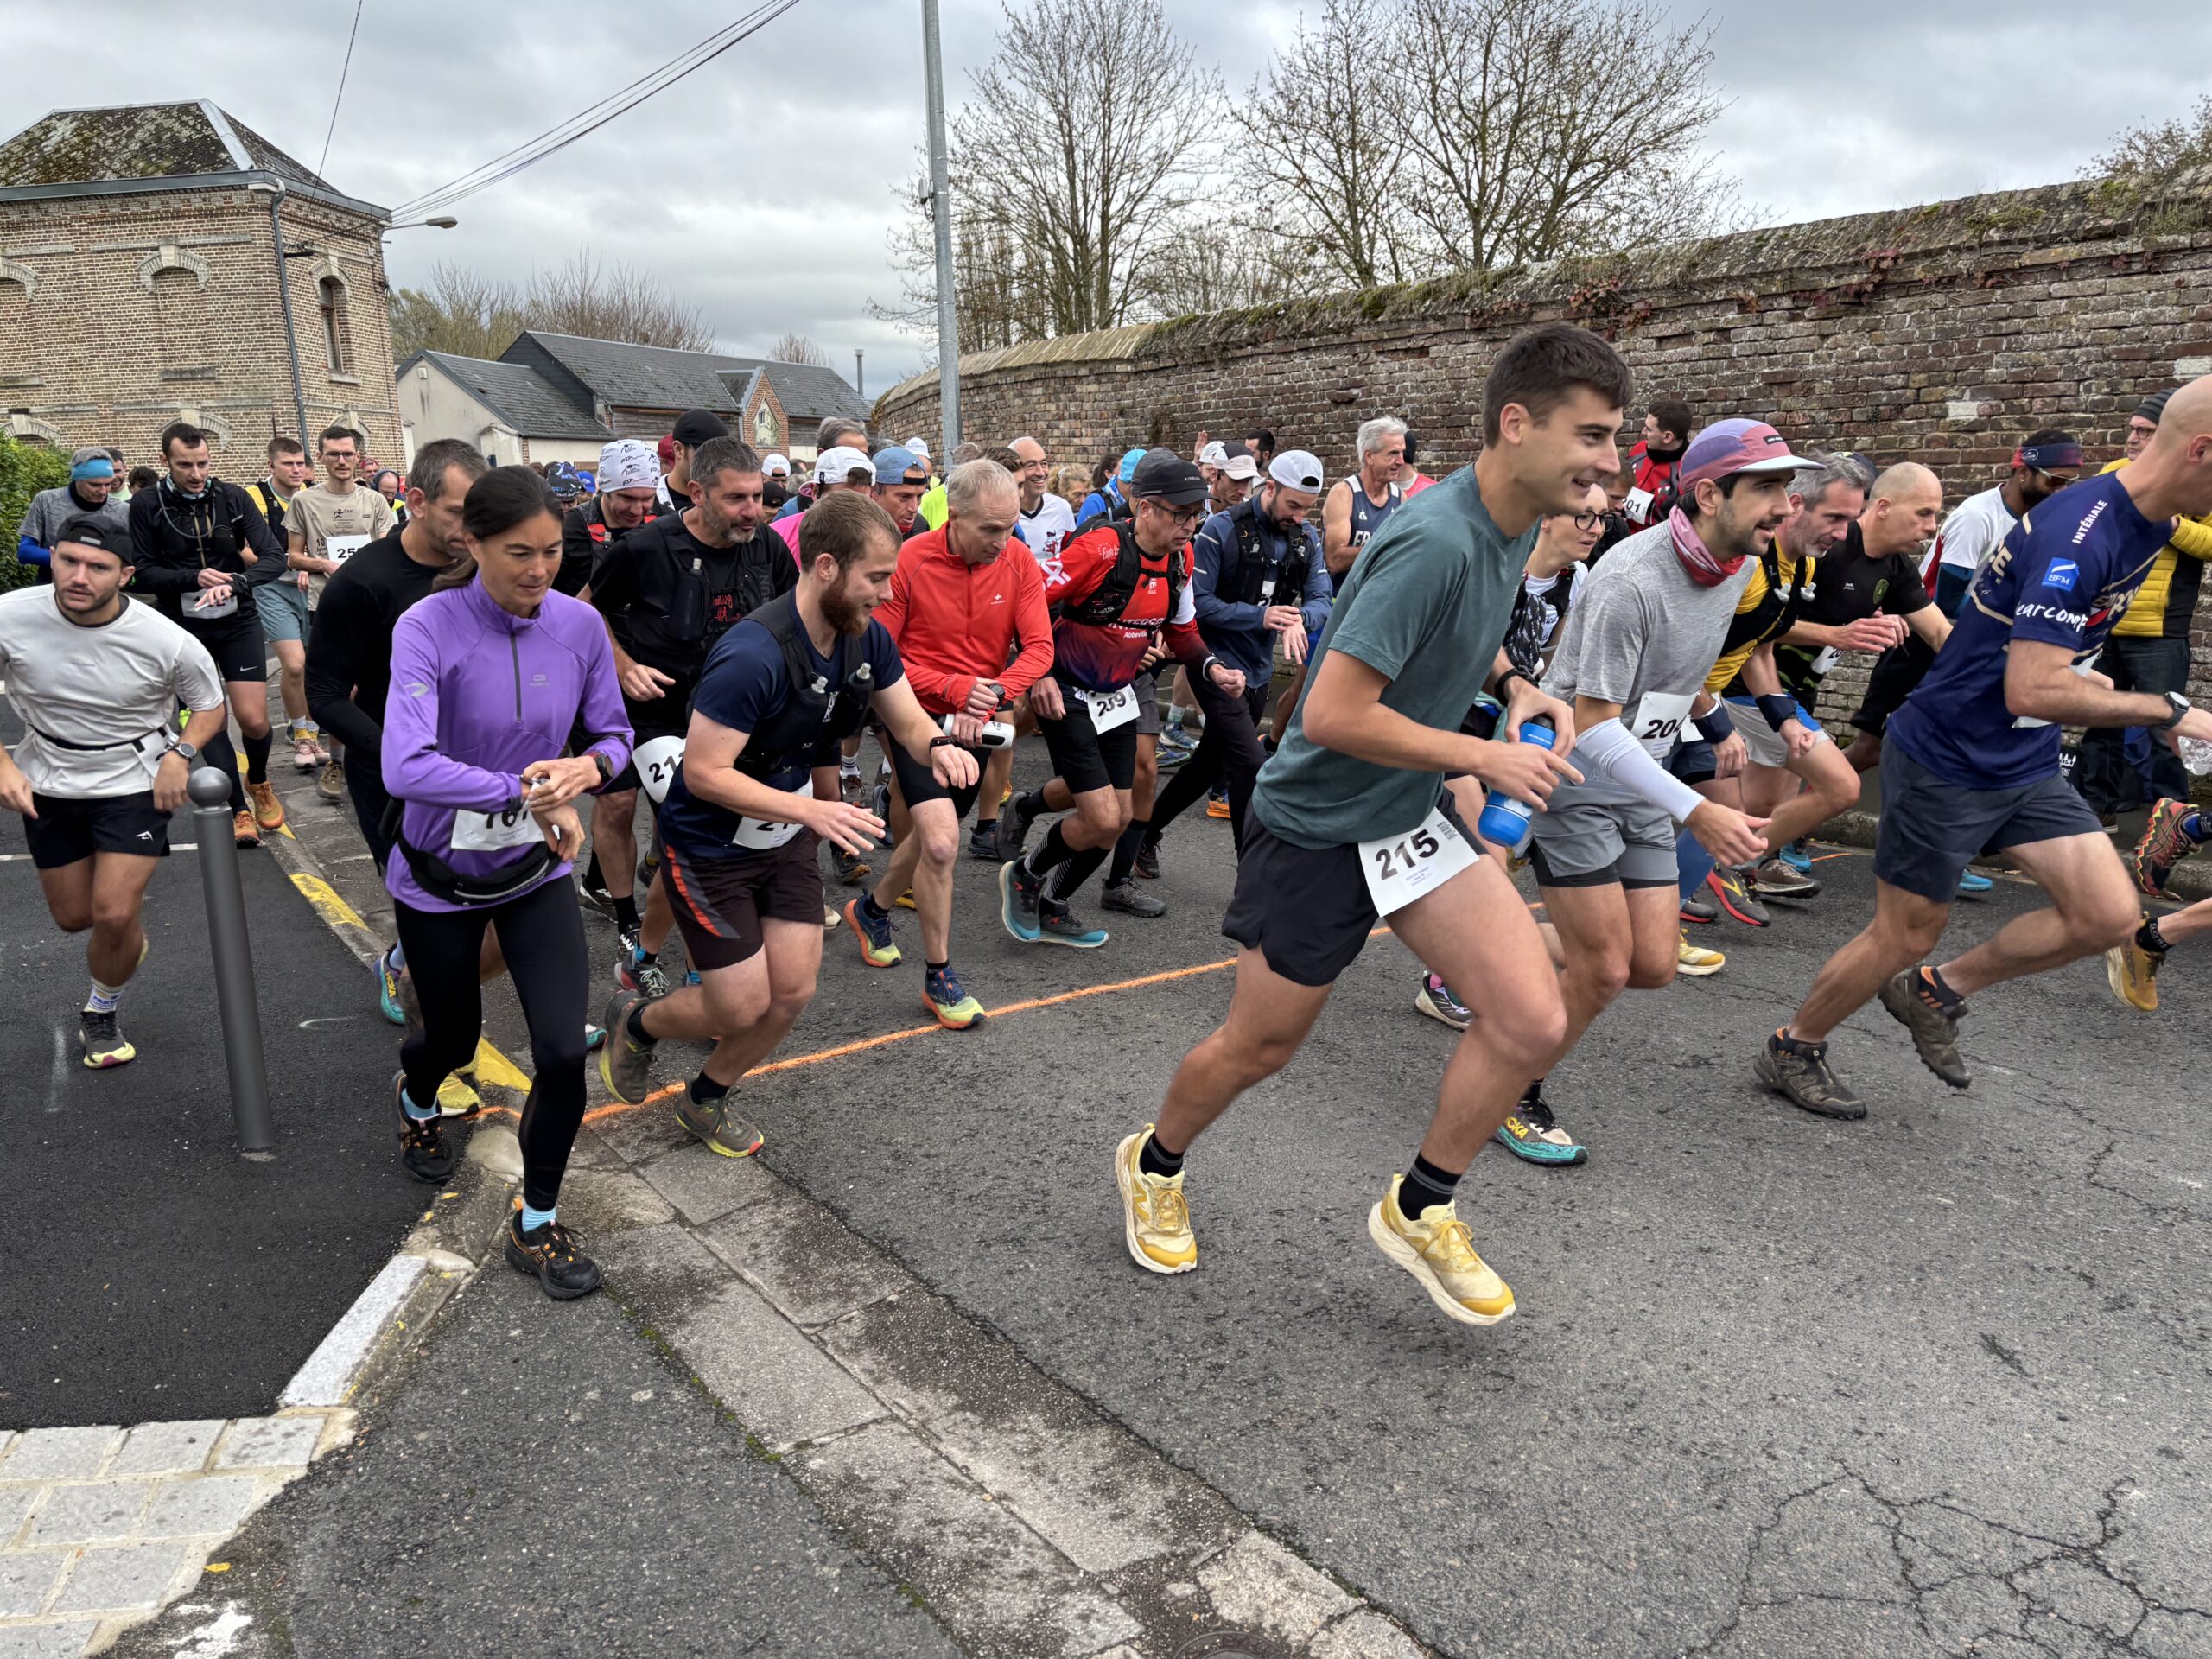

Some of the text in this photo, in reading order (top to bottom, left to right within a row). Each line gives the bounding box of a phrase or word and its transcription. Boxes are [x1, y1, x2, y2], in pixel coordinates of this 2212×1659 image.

[2072, 499, 2108, 545] INTÉRIALE
[337, 547, 360, 559] 25
[2048, 574, 2070, 585] BFM
[1376, 829, 1440, 881] 215
